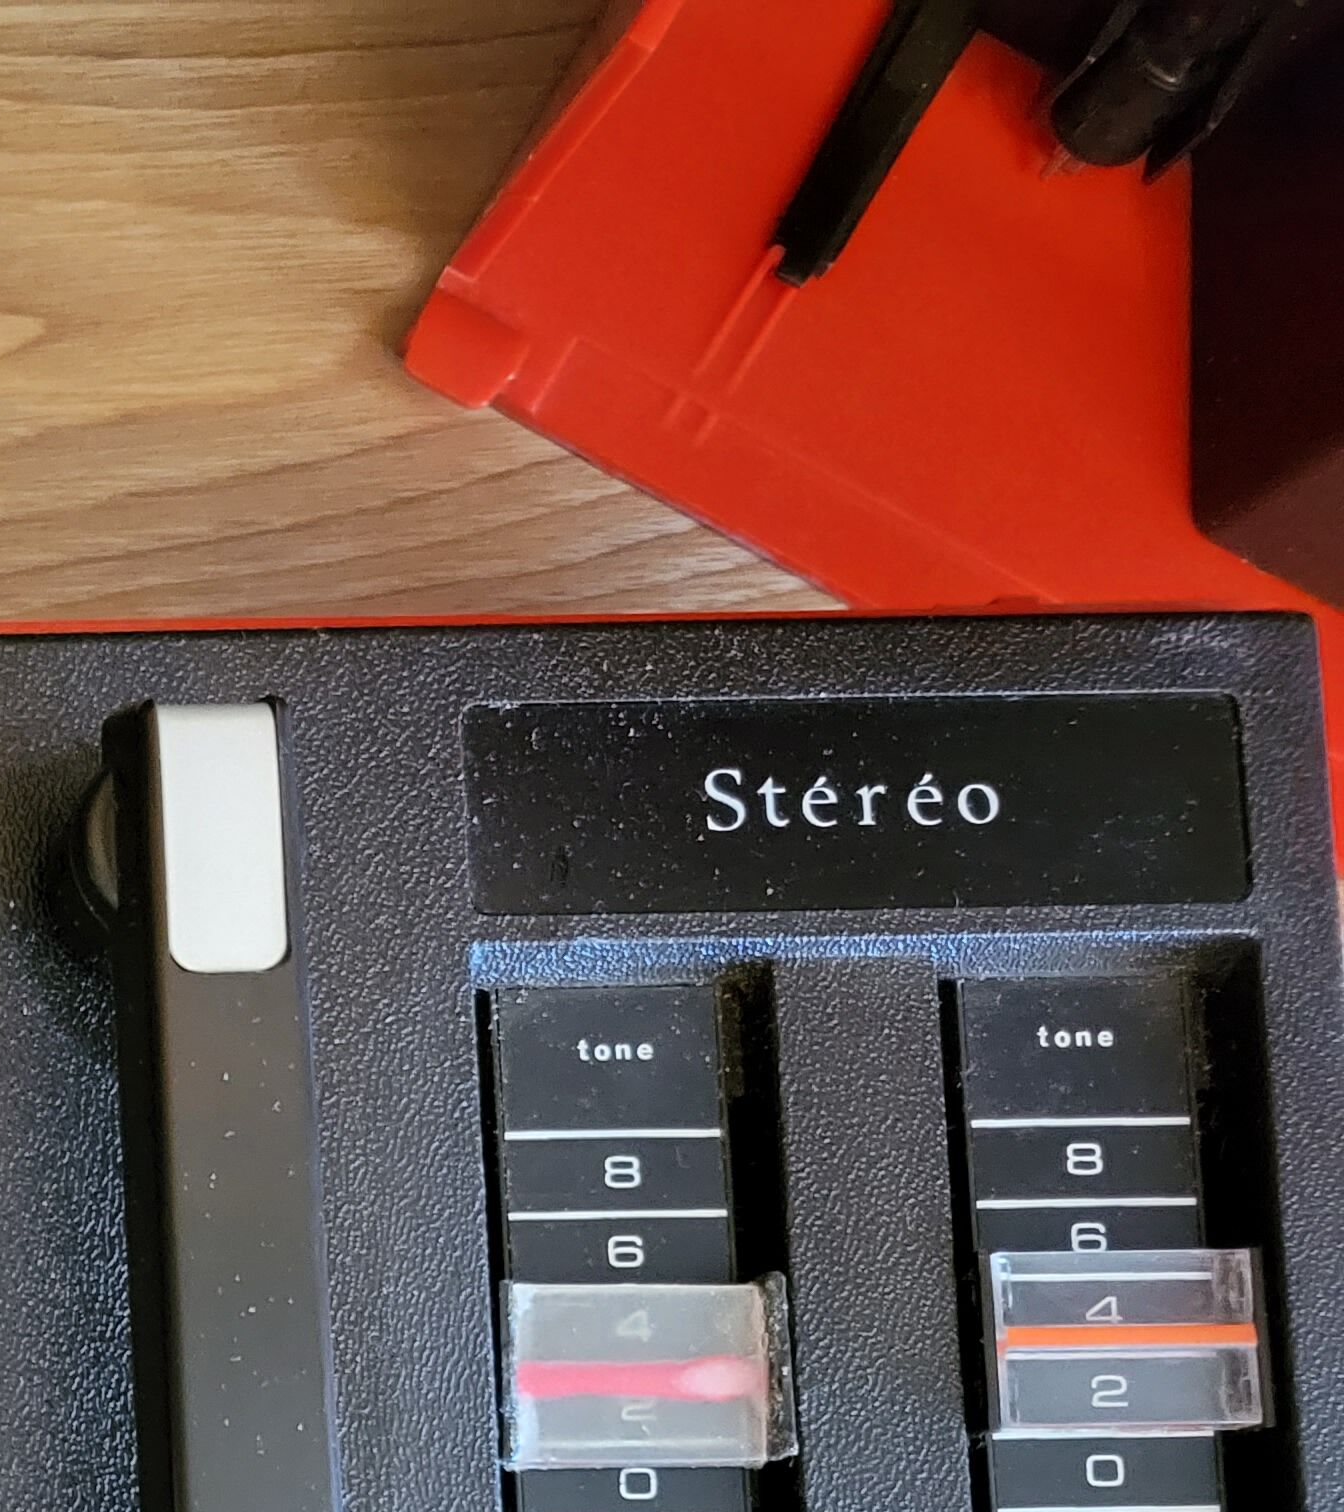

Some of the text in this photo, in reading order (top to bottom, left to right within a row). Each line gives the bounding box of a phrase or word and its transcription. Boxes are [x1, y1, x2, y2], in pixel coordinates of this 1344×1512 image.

[704, 768, 1000, 832] Stéréo
[576, 1039, 654, 1062] tone
[1036, 1025, 1114, 1048] tone
[604, 1155, 642, 1189] 8
[1066, 1142, 1104, 1176] 8
[607, 1235, 645, 1268] 6
[1070, 1221, 1108, 1251] 6
[615, 1308, 653, 1343] 4
[1085, 1295, 1124, 1325] 4
[1091, 1374, 1129, 1408] 2
[619, 1467, 658, 1500] 0
[1085, 1454, 1125, 1487] 0
